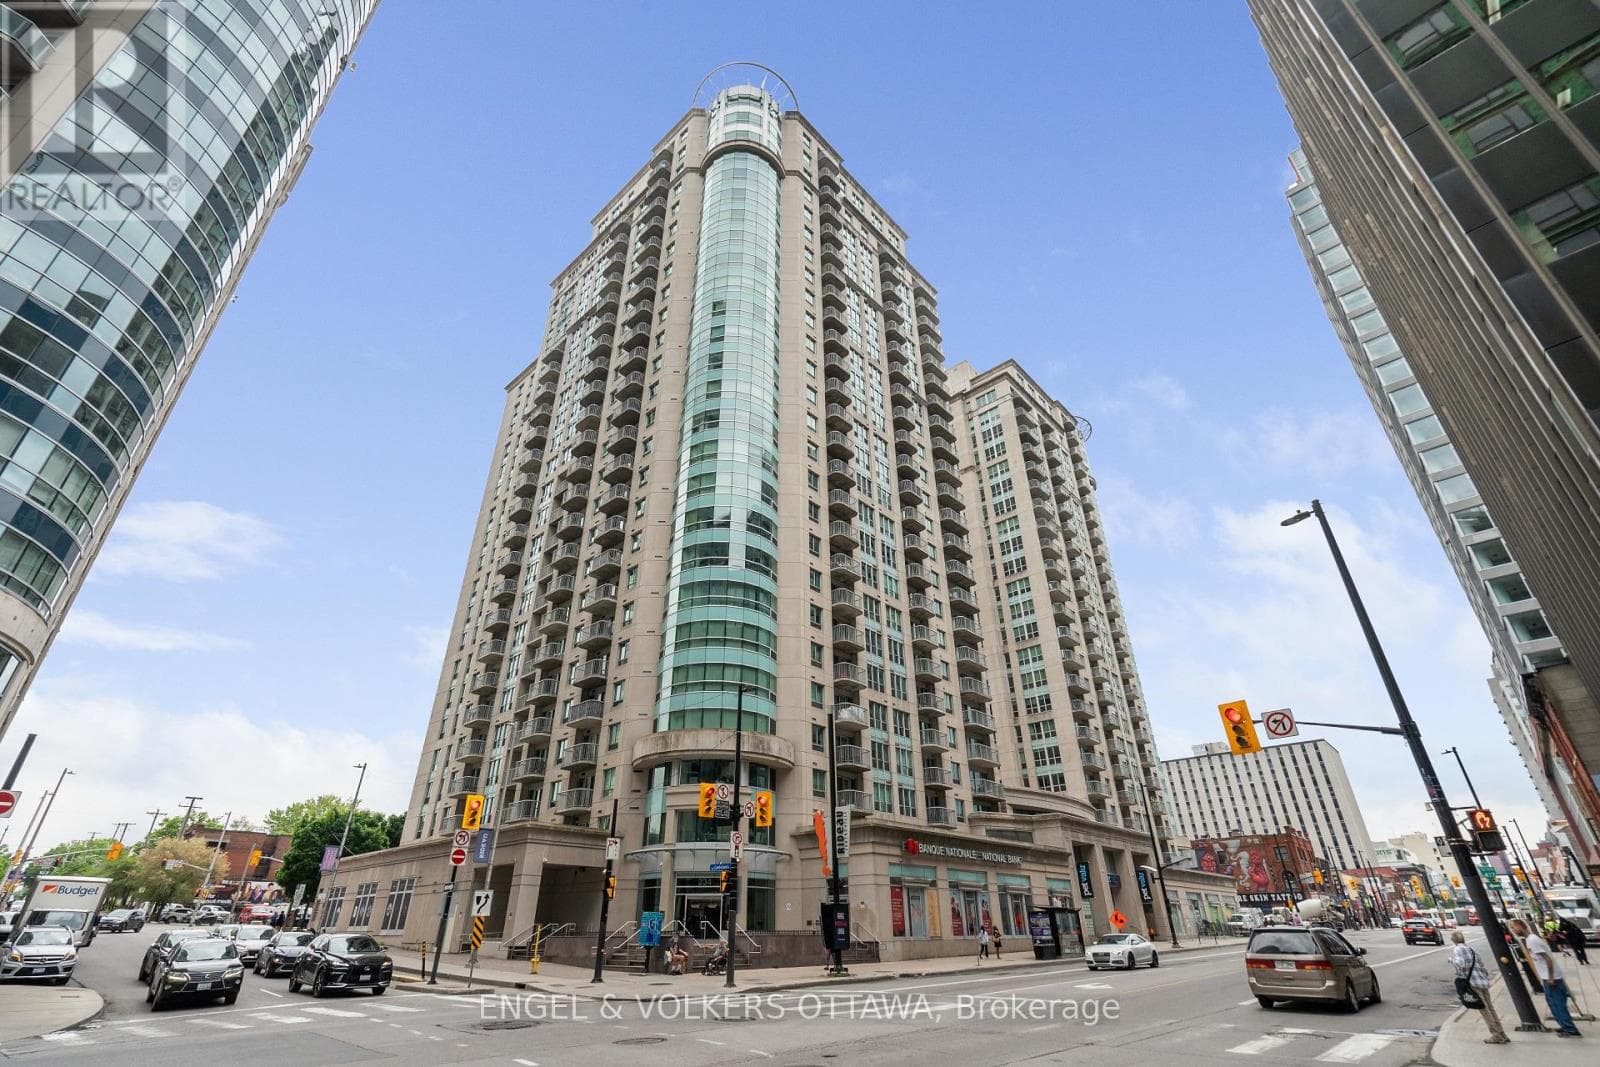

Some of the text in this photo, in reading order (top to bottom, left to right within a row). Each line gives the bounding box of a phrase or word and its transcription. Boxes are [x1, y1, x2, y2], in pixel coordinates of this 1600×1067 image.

[919, 843, 1023, 865] BANQUE NATIONALE NATIONAL BANK
[57, 885, 99, 897] Budget
[1249, 894, 1269, 902] SKIN
